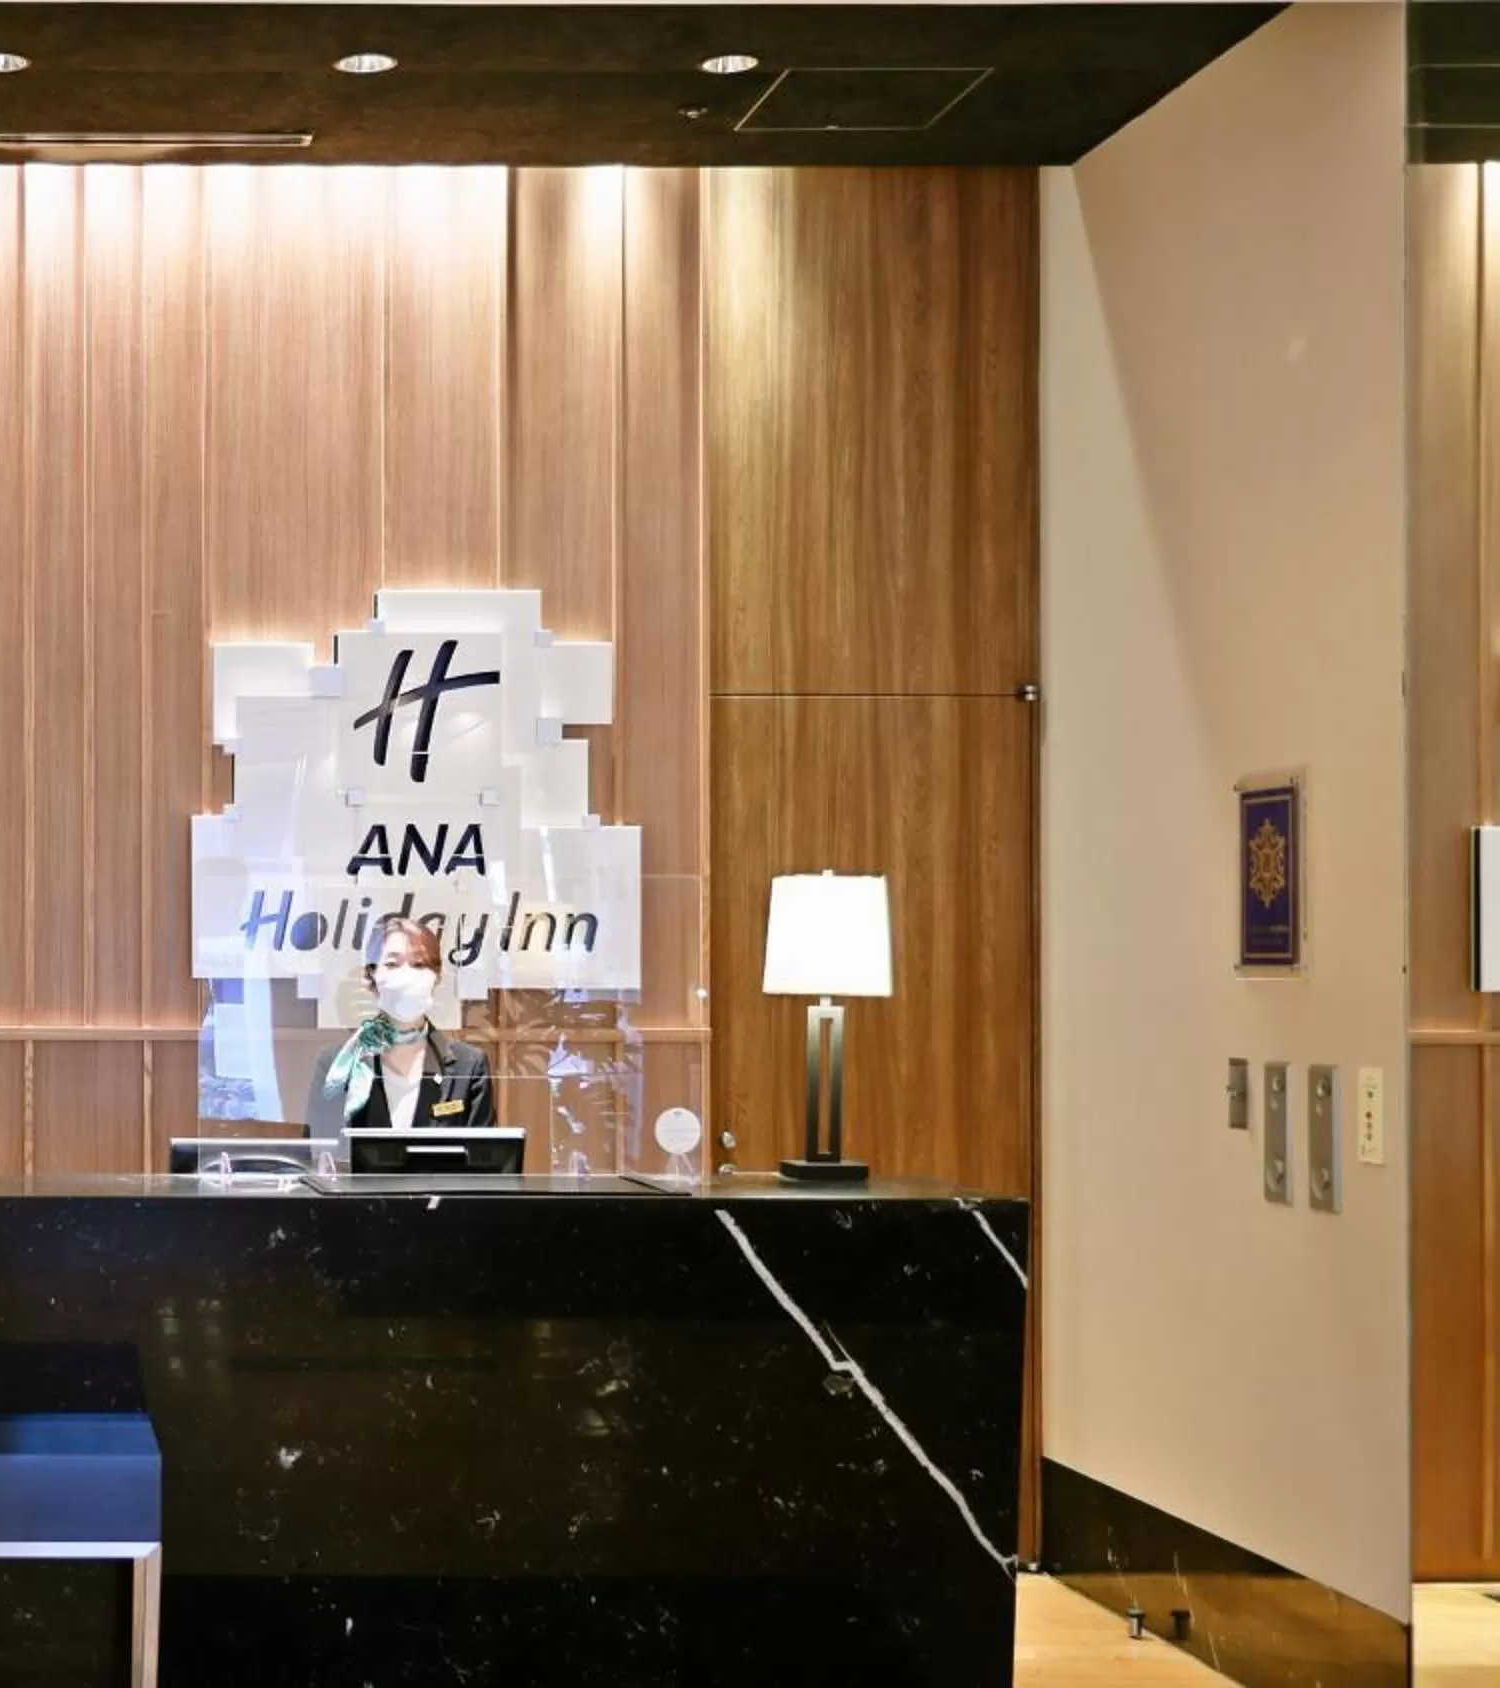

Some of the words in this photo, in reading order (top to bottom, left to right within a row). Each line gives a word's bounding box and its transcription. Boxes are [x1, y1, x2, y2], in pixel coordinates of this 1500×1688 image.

[353, 639, 500, 782] H
[346, 823, 486, 876] ANA
[500, 891, 599, 952] Inn
